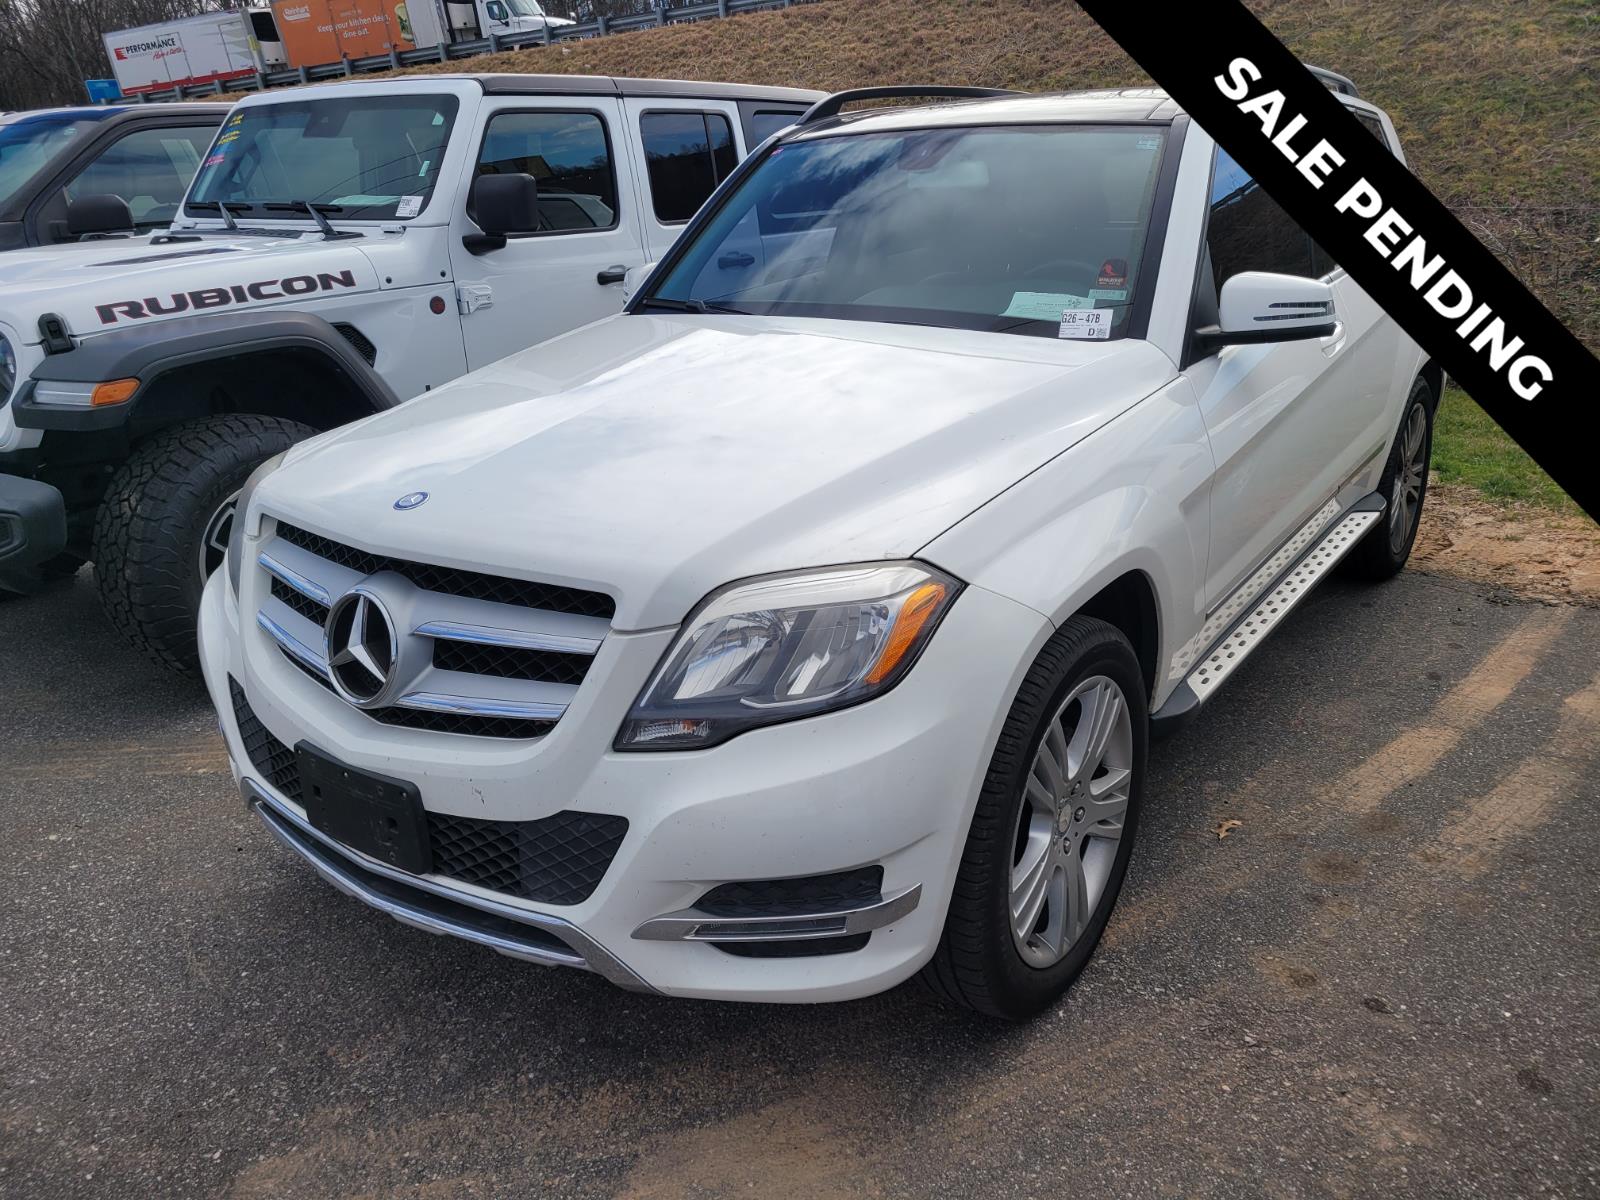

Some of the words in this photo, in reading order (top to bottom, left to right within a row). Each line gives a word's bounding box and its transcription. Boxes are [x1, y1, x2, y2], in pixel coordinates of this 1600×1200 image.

[317, 24, 334, 33] Keep
[335, 21, 348, 31] your
[349, 17, 372, 28] kitchen
[125, 38, 176, 54] PERFORMANCE
[95, 270, 357, 325] RUBICON
[1087, 327, 1096, 337] D
